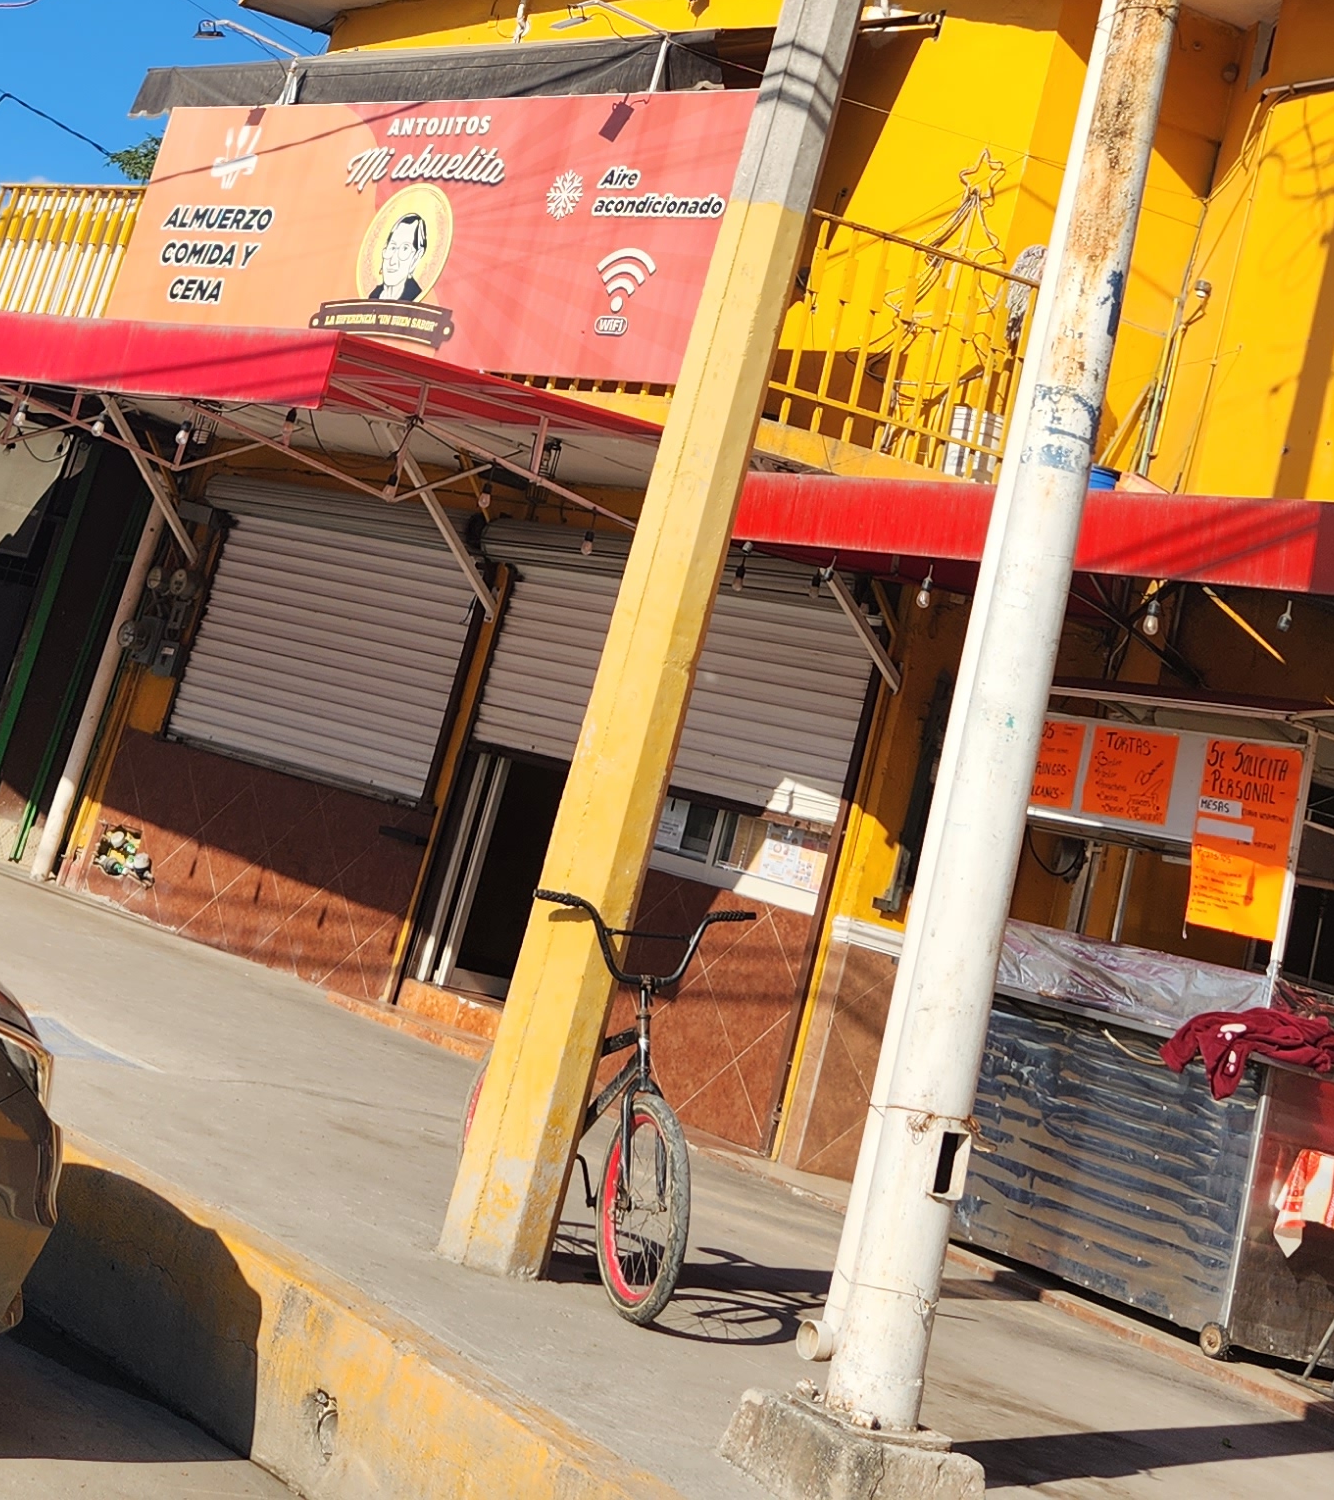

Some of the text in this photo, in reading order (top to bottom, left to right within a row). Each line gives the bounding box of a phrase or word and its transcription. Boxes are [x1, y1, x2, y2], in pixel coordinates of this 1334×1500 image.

[387, 115, 492, 137] ANTOJITOS
[345, 143, 506, 194] Mi abuelita
[598, 167, 640, 188] Aire
[593, 193, 725, 216] acondicionado
[162, 205, 274, 232] ALMUERZO
[161, 240, 260, 267] COMIDA Y
[168, 277, 224, 303] CENA
[1200, 799, 1230, 813] MESAS
